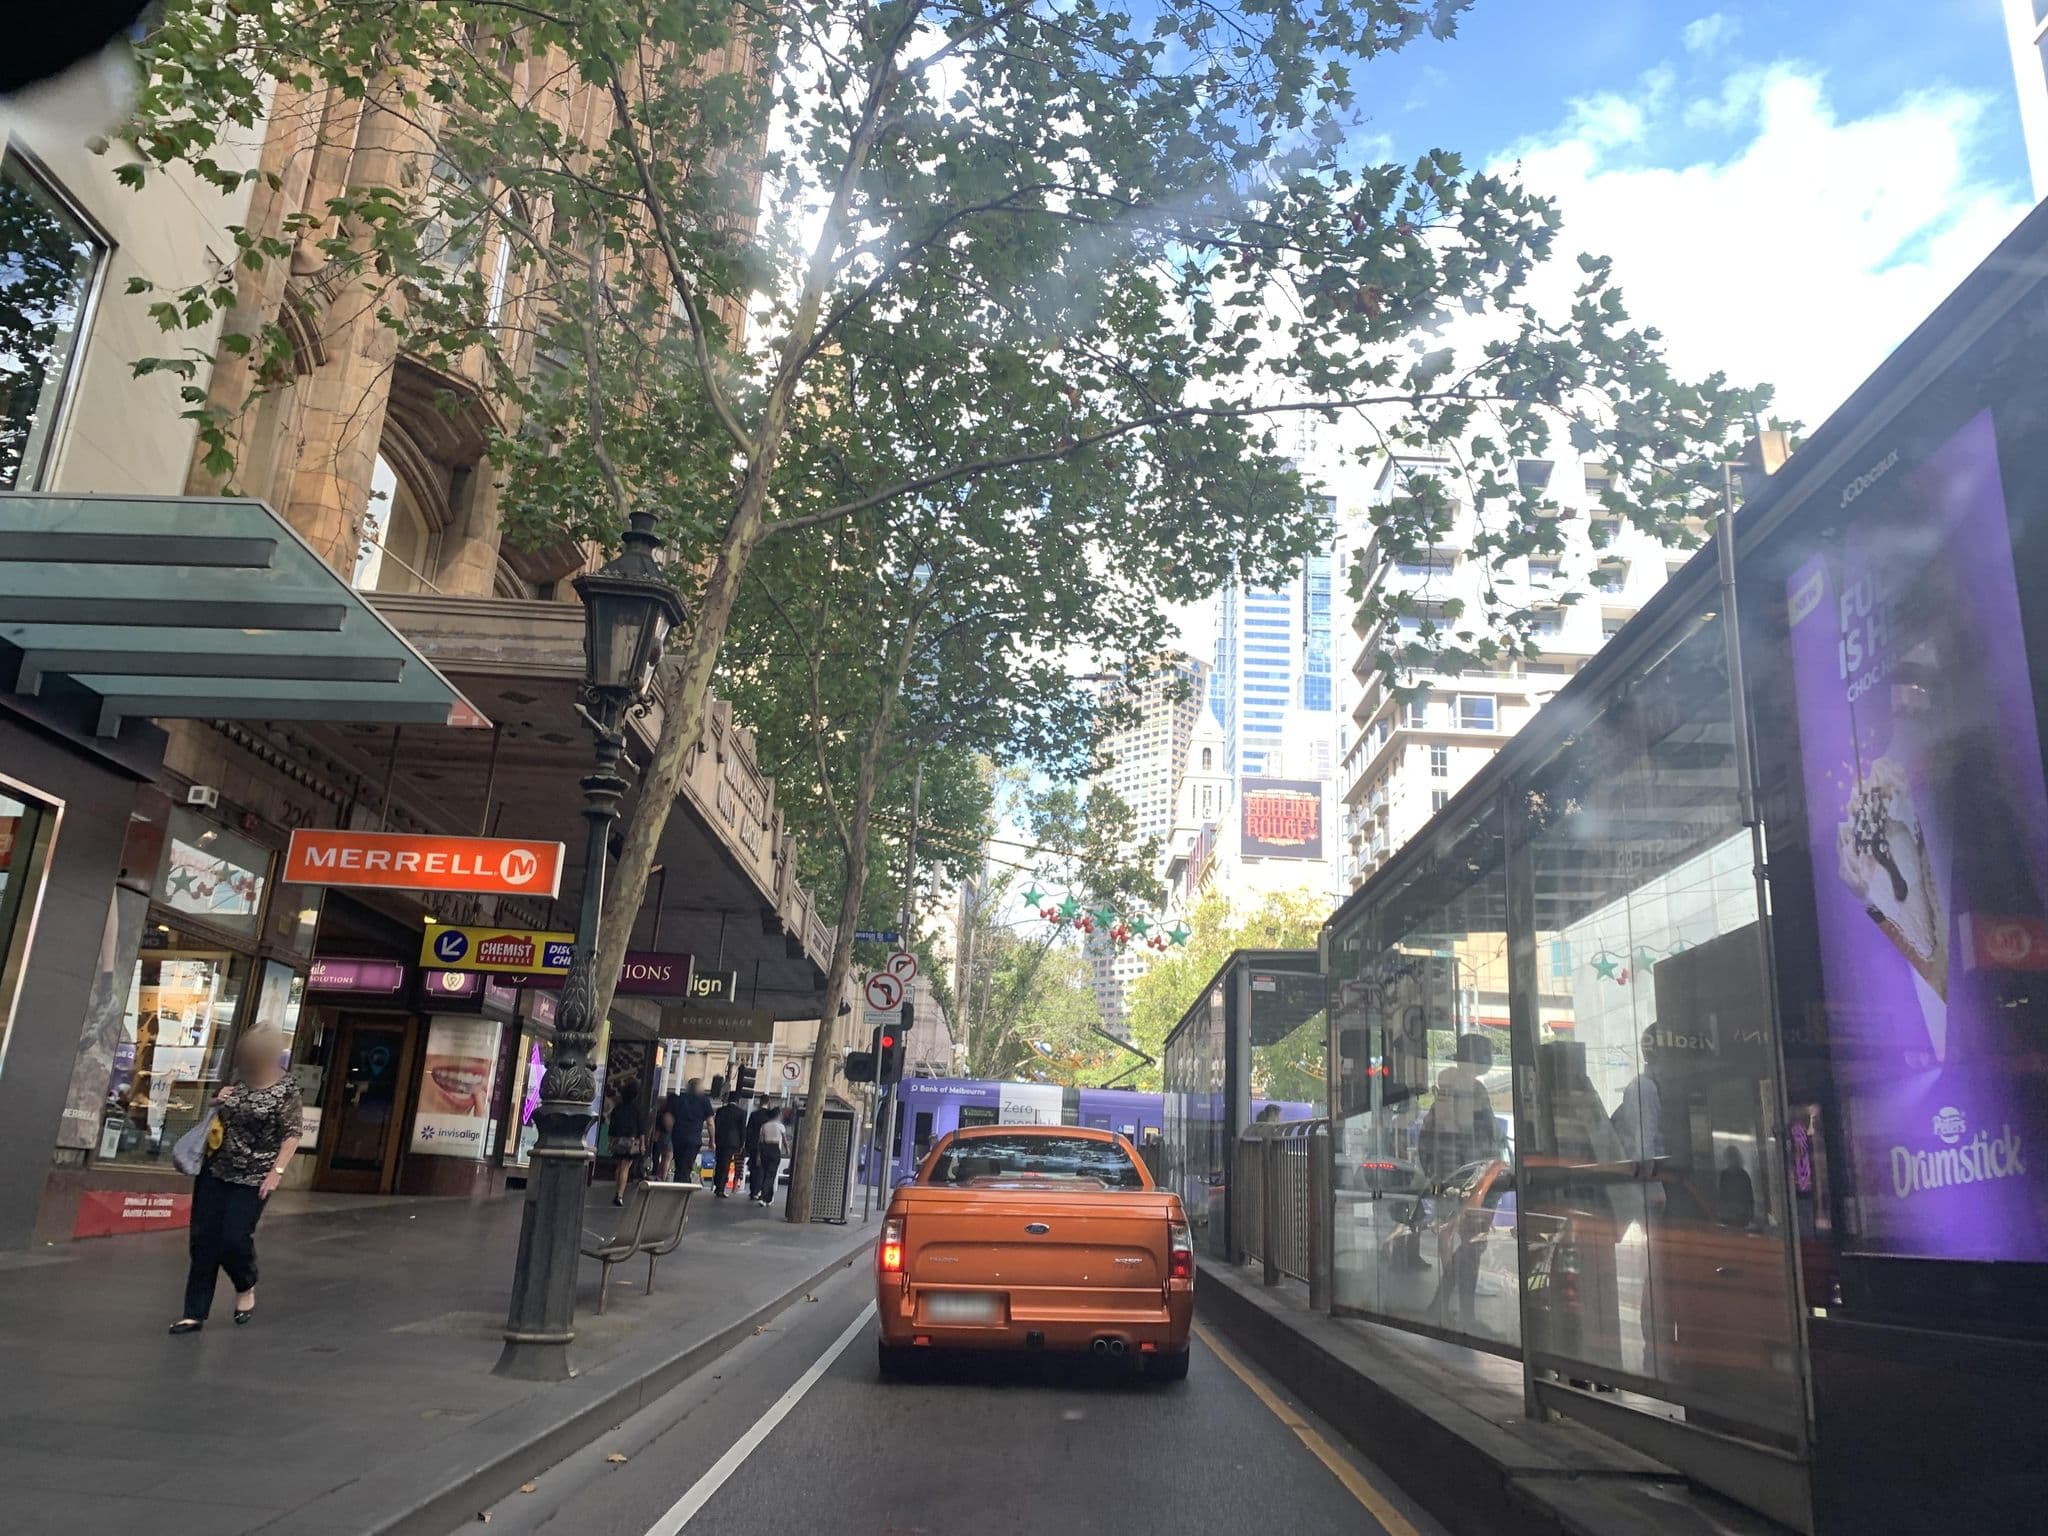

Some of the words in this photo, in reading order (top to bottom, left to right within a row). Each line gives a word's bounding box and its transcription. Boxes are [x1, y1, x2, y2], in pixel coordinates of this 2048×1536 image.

[1840, 449, 1899, 508] JCDecaux
[304, 847, 495, 876] MERRELL
[480, 942, 533, 958] CHEMIST
[479, 956, 531, 965] WAREHOUSE
[622, 964, 672, 981] IONS
[920, 1085, 938, 1093] Bank
[940, 1085, 949, 1093] of
[950, 1086, 986, 1096] Melbourne
[1004, 1101, 1033, 1114] Zero
[438, 1128, 480, 1141] invisalign
[1890, 1124, 2026, 1199] Drumstick
